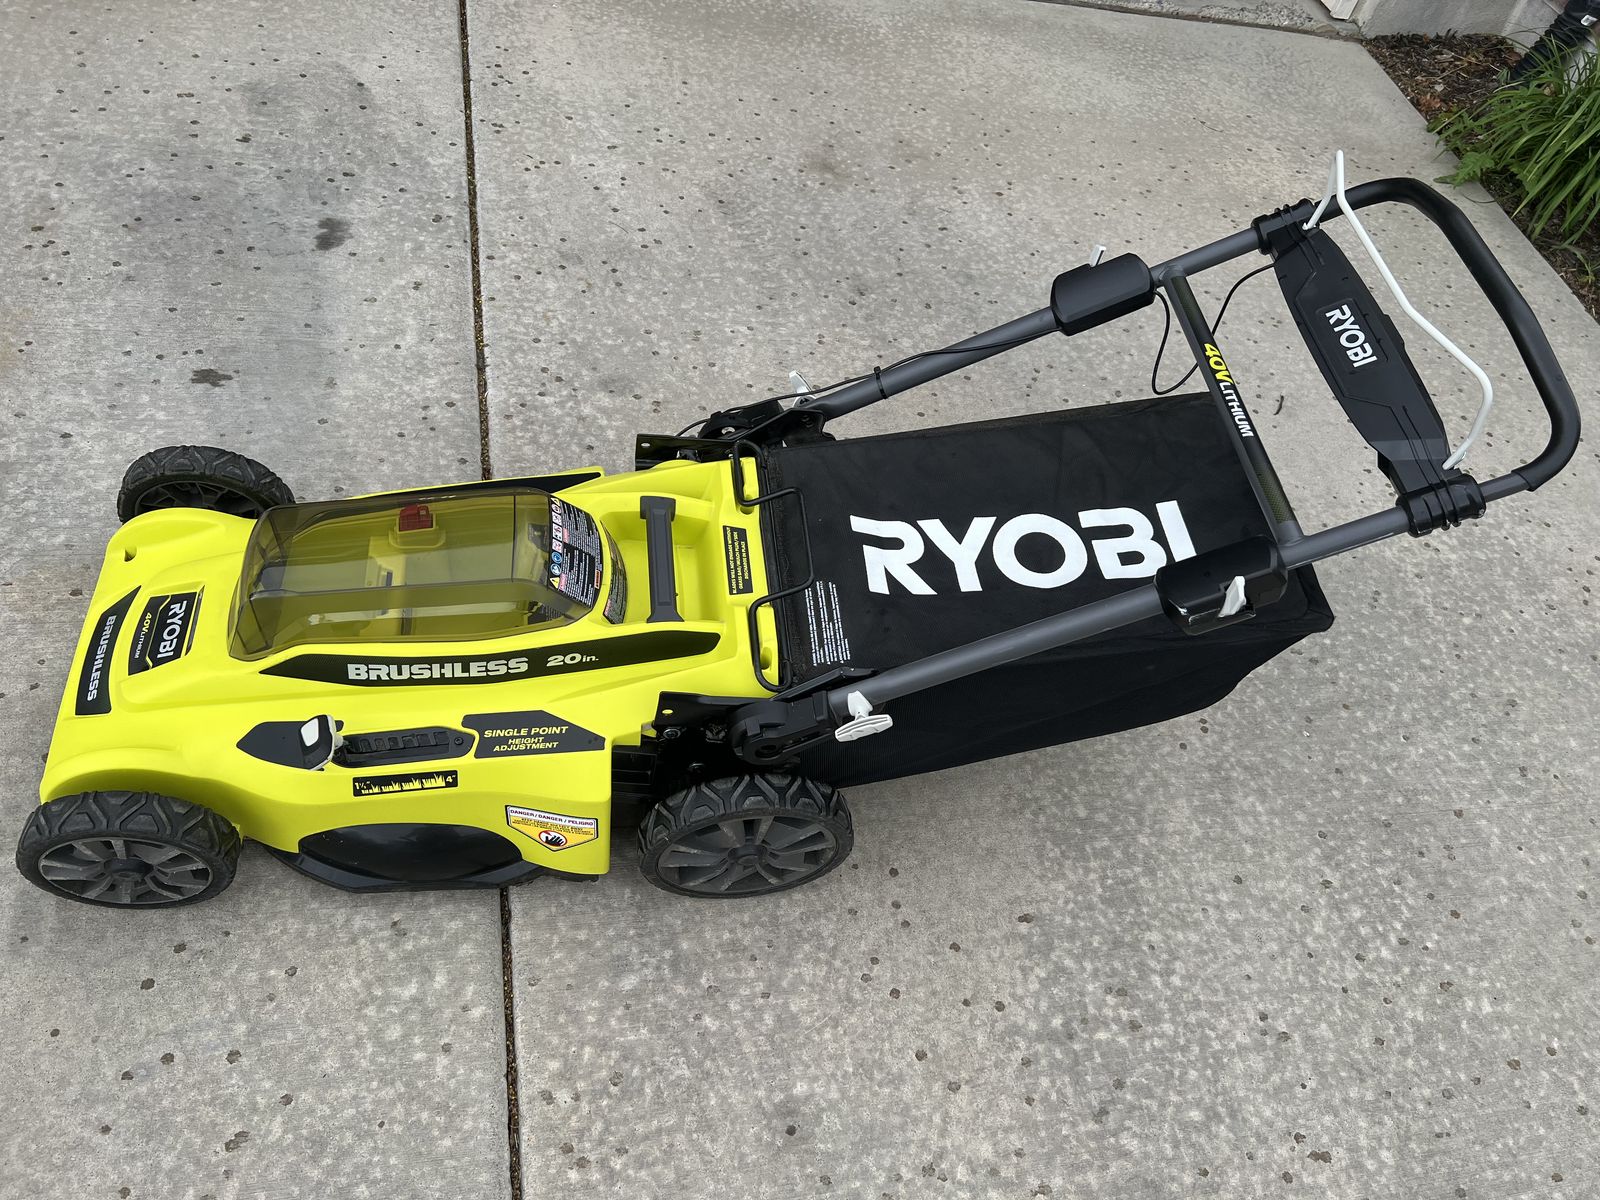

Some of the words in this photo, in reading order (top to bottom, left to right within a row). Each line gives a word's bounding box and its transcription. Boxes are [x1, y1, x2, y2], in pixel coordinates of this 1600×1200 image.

[1325, 304, 1378, 368] RYOBI
[849, 500, 1198, 596] RYOBI
[156, 600, 188, 659] RYOBI
[86, 615, 117, 701] BRUSHLESS
[347, 657, 529, 681] BRUSHLESS
[484, 727, 528, 738] SINGLE
[531, 726, 569, 735] POINT
[508, 737, 544, 745] HEIGHT
[493, 742, 559, 752] ADJUSTMENT
[510, 809, 534, 818] DANGER
[538, 814, 563, 822] DANGER
